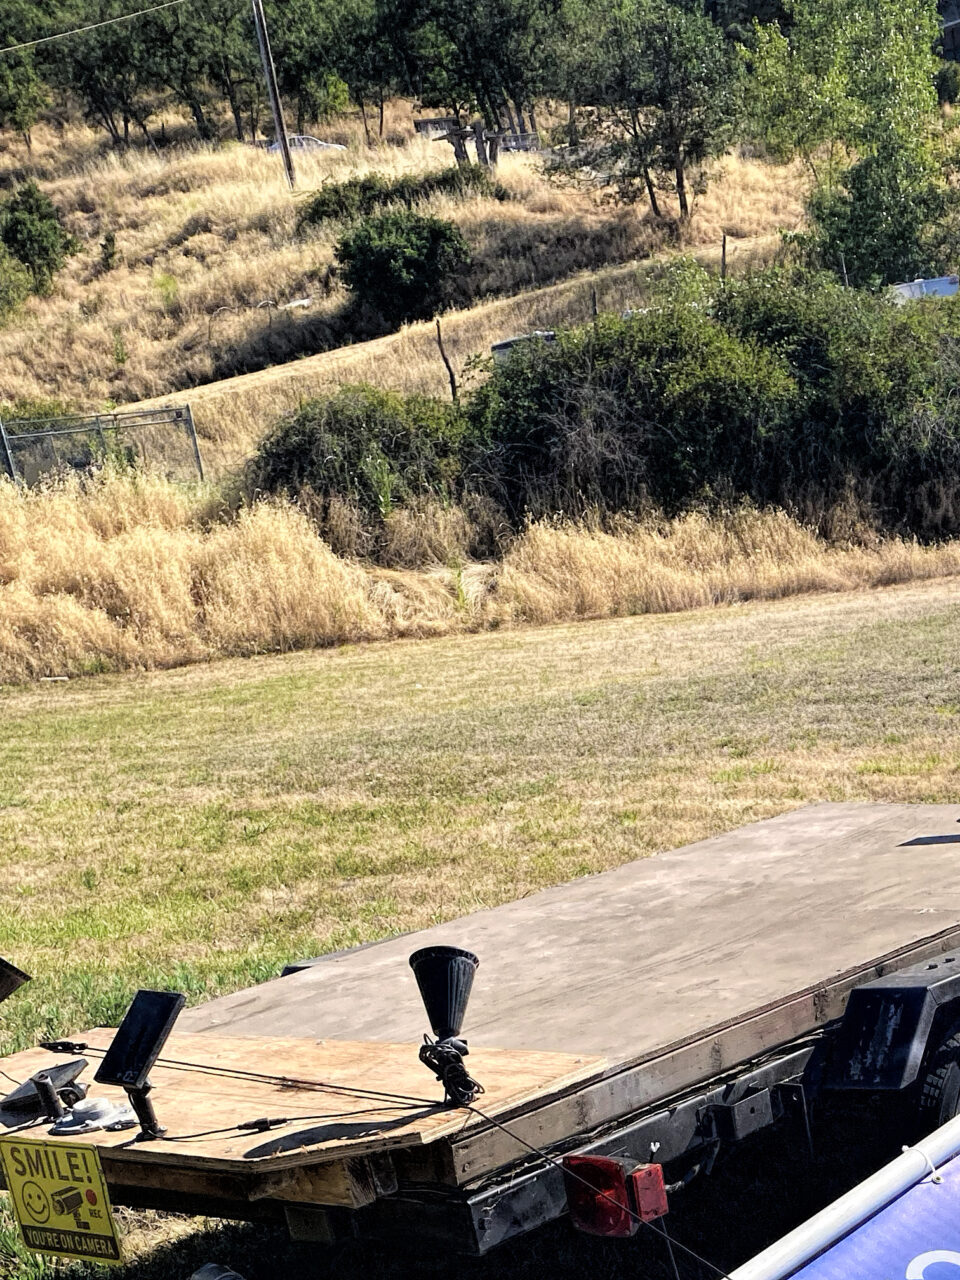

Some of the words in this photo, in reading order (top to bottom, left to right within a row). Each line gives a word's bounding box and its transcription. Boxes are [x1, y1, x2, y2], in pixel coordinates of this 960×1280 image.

[10, 1146, 92, 1184] SMILE!
[88, 1208, 104, 1219] REC
[26, 1228, 60, 1247] YOU'RE
[61, 1234, 74, 1250] ON
[74, 1236, 115, 1256] CAMERA
